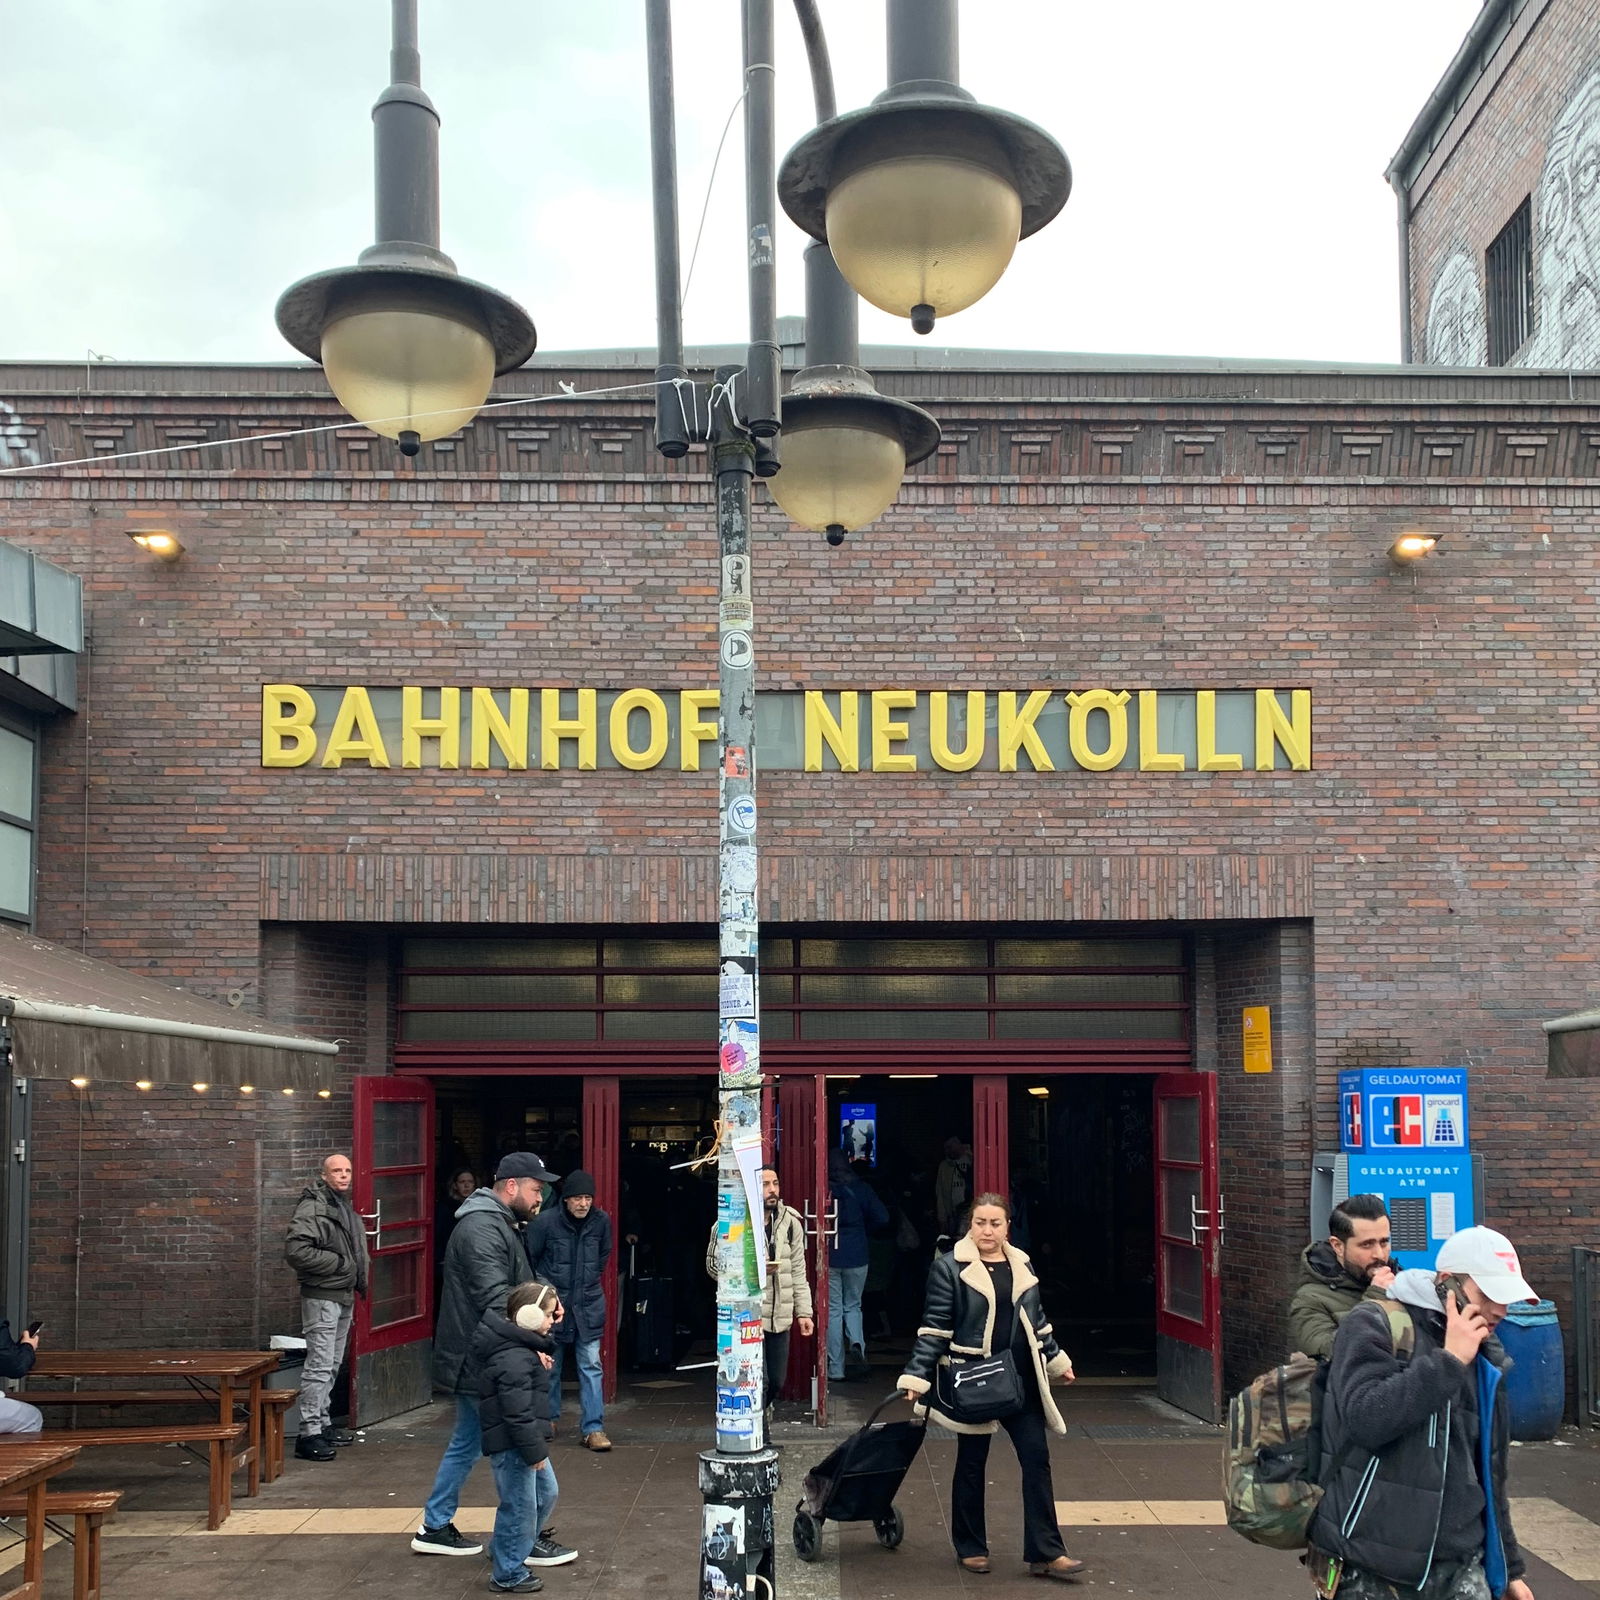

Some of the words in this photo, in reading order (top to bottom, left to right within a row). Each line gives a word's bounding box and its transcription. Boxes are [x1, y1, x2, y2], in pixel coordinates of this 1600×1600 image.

[262, 684, 721, 771] BAHNHOF
[804, 688, 1311, 772] NEUKÖLLN
[1369, 1074, 1462, 1085] GELDAUTOMAT
[1427, 1098, 1460, 1107] girocard
[1360, 1167, 1460, 1176] GELDAUTOMAT
[1399, 1179, 1426, 1187] ATM
